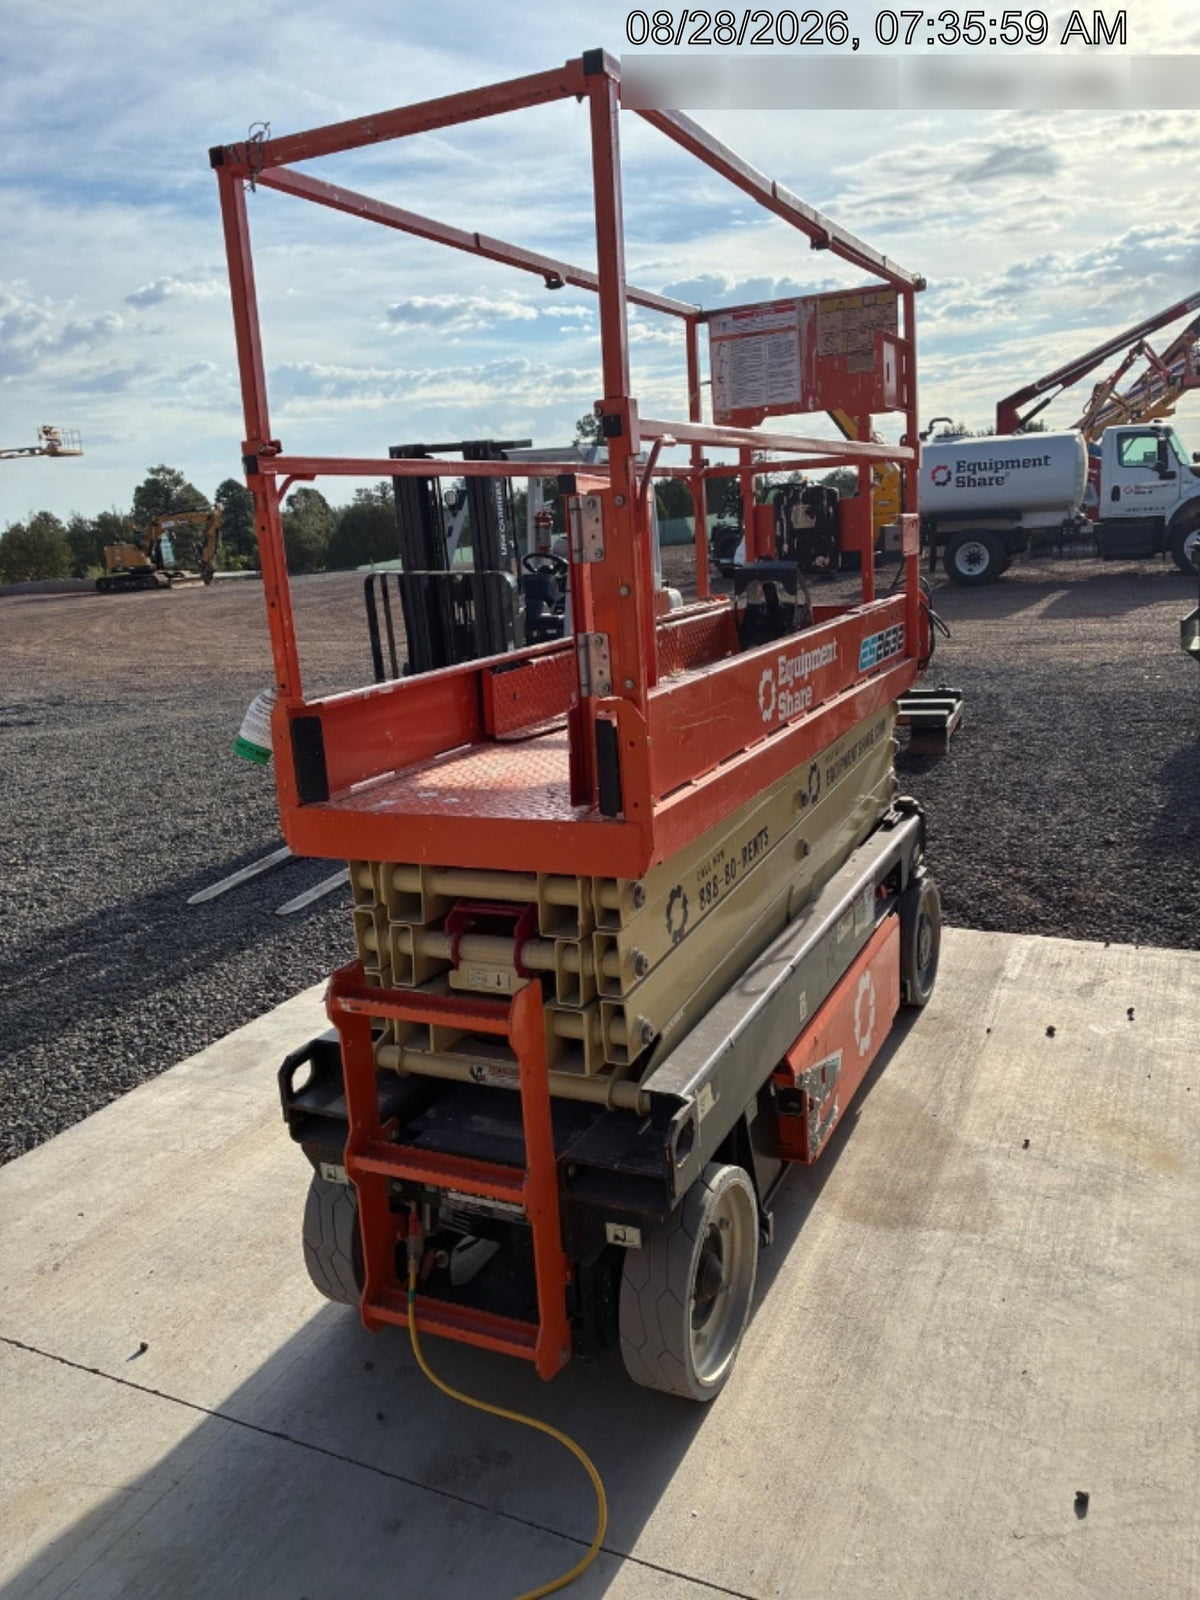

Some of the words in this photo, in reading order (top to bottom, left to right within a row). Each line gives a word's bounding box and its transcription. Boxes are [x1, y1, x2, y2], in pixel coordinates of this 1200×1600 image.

[956, 454, 1051, 475] Equipment
[777, 636, 838, 688] Equipment
[777, 685, 813, 721] Share
